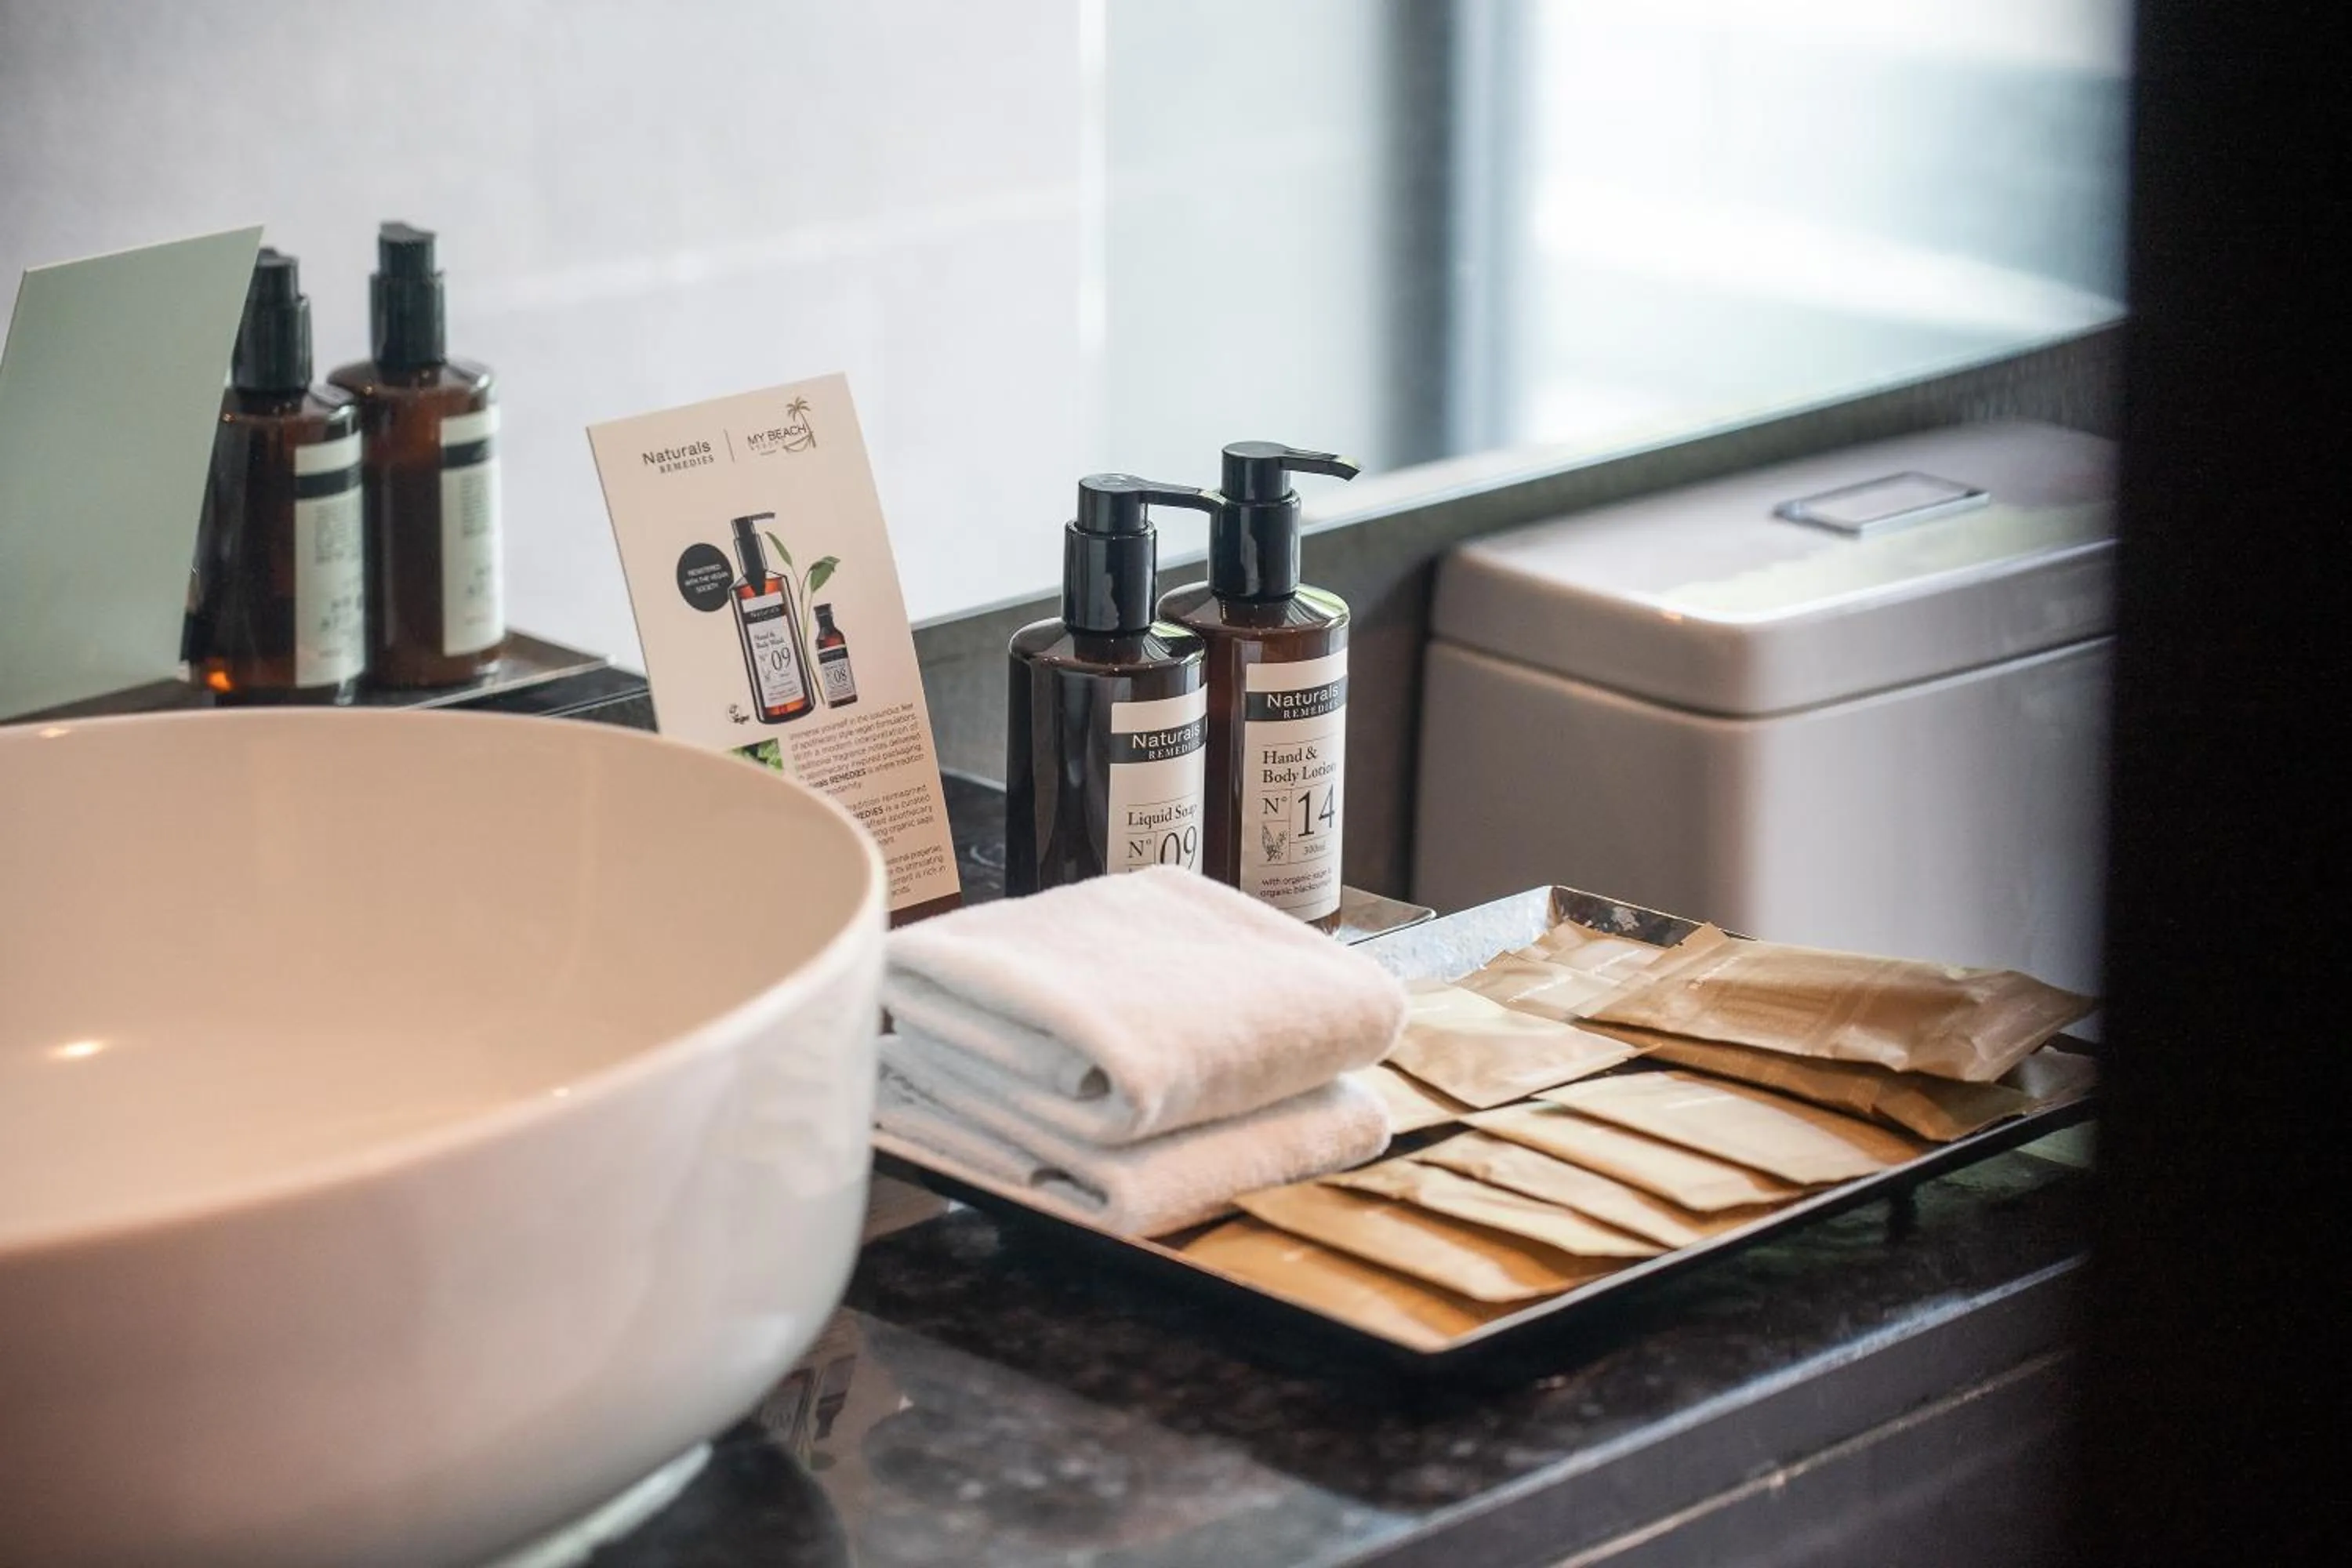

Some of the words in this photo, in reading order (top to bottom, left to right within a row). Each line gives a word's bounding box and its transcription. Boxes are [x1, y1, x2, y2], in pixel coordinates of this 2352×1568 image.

[747, 432, 764, 446] MY
[768, 424, 807, 441] BEACH
[641, 441, 711, 465] Naturals
[659, 454, 714, 474] REMEDIES
[771, 647, 790, 670] 09
[1267, 684, 1338, 709] Naturals
[1283, 700, 1339, 719] REMEDIES
[1132, 722, 1201, 749] Naturals
[833, 747, 866, 763] fragrance
[1149, 739, 1201, 760] REMEDIES
[1262, 747, 1302, 764] Hand
[1305, 746, 1317, 760] &
[829, 768, 866, 783] REMEDIES
[1262, 768, 1299, 786] Body
[1302, 762, 1336, 780] Lotion
[902, 793, 931, 808] curated
[1298, 784, 1334, 837] 14
[889, 820, 916, 833] organic
[1128, 807, 1172, 829] Liquid
[1175, 803, 1197, 819] Soap
[1160, 826, 1197, 872] 09
[1262, 877, 1280, 886] with
[1283, 873, 1311, 886] organic
[1260, 887, 1293, 898] organic
